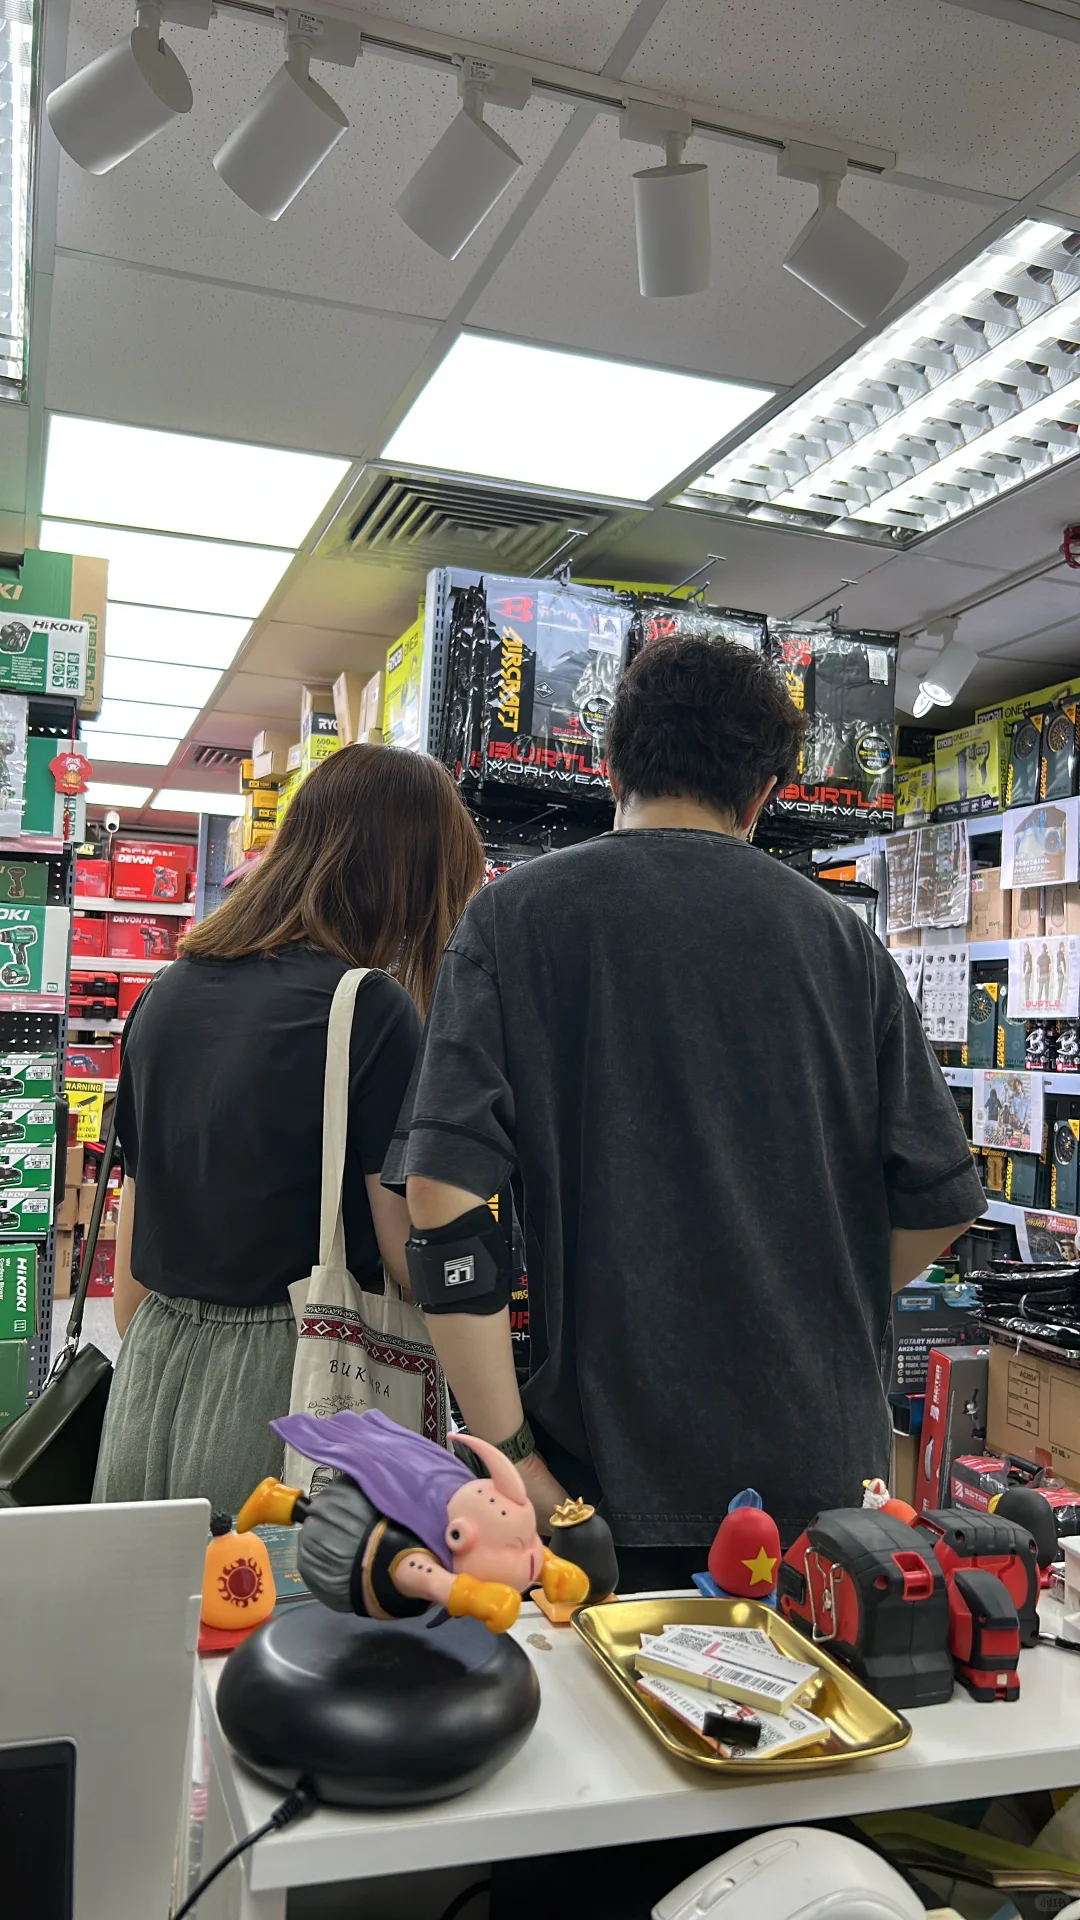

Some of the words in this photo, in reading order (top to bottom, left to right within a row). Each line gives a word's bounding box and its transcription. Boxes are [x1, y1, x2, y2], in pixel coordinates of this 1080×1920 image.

[778, 783, 895, 809] BURTLE
[776, 797, 894, 820] WORKWEAR
[117, 854, 154, 865] DEVON
[112, 915, 142, 925] DEVON
[65, 1082, 102, 1092] WARNING
[79, 1115, 96, 1124] TV
[16, 1256, 28, 1312] HiKOKI
[898, 1338, 925, 1346] ROTARY
[925, 1337, 956, 1345] HAMMER
